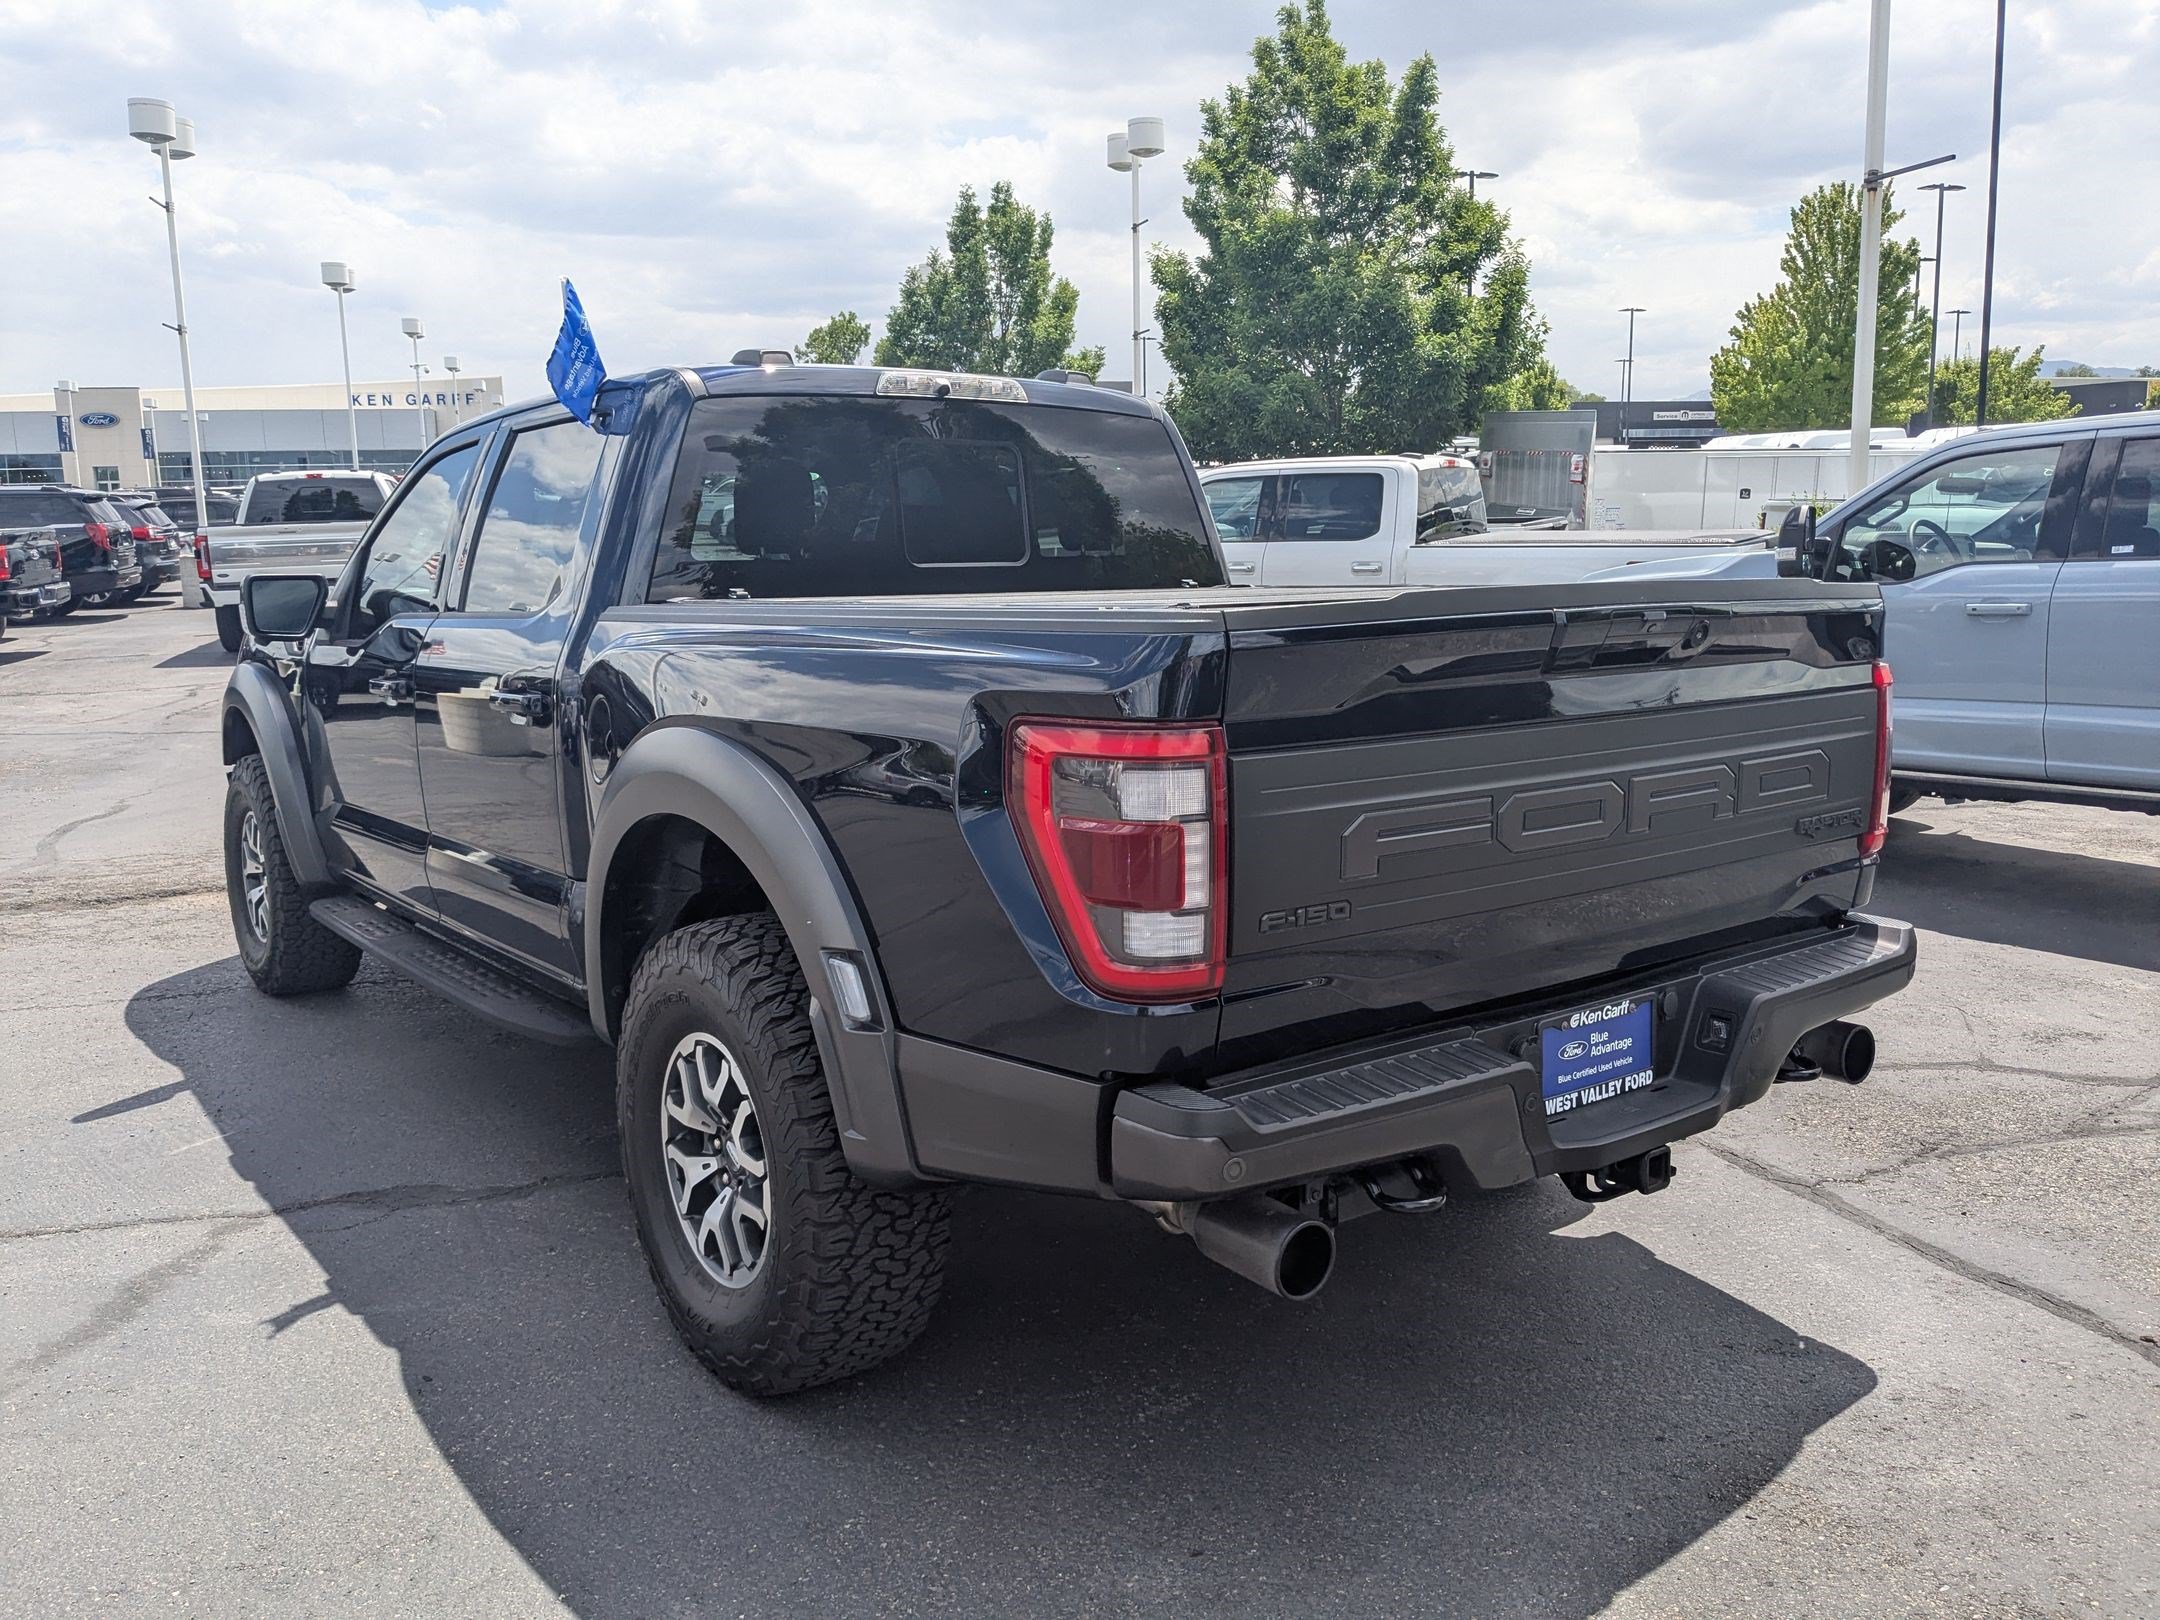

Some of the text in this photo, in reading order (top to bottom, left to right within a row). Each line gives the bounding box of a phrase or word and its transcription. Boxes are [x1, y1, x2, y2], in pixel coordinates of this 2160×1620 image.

[352, 394, 392, 406] KEN
[87, 415, 111, 425] Ford
[1340, 749, 1832, 881] FORD
[1258, 899, 1351, 933] F-150
[1580, 1000, 1630, 1027] Ken Garff
[1590, 1031, 1609, 1044] Blue
[1590, 1037, 1633, 1057] Advantage
[1563, 1043, 1583, 1058] Ford
[1558, 1056, 1633, 1084] Blue Certified Used Vehicle
[1545, 1070, 1653, 1116] WEST VALLEY FORD
